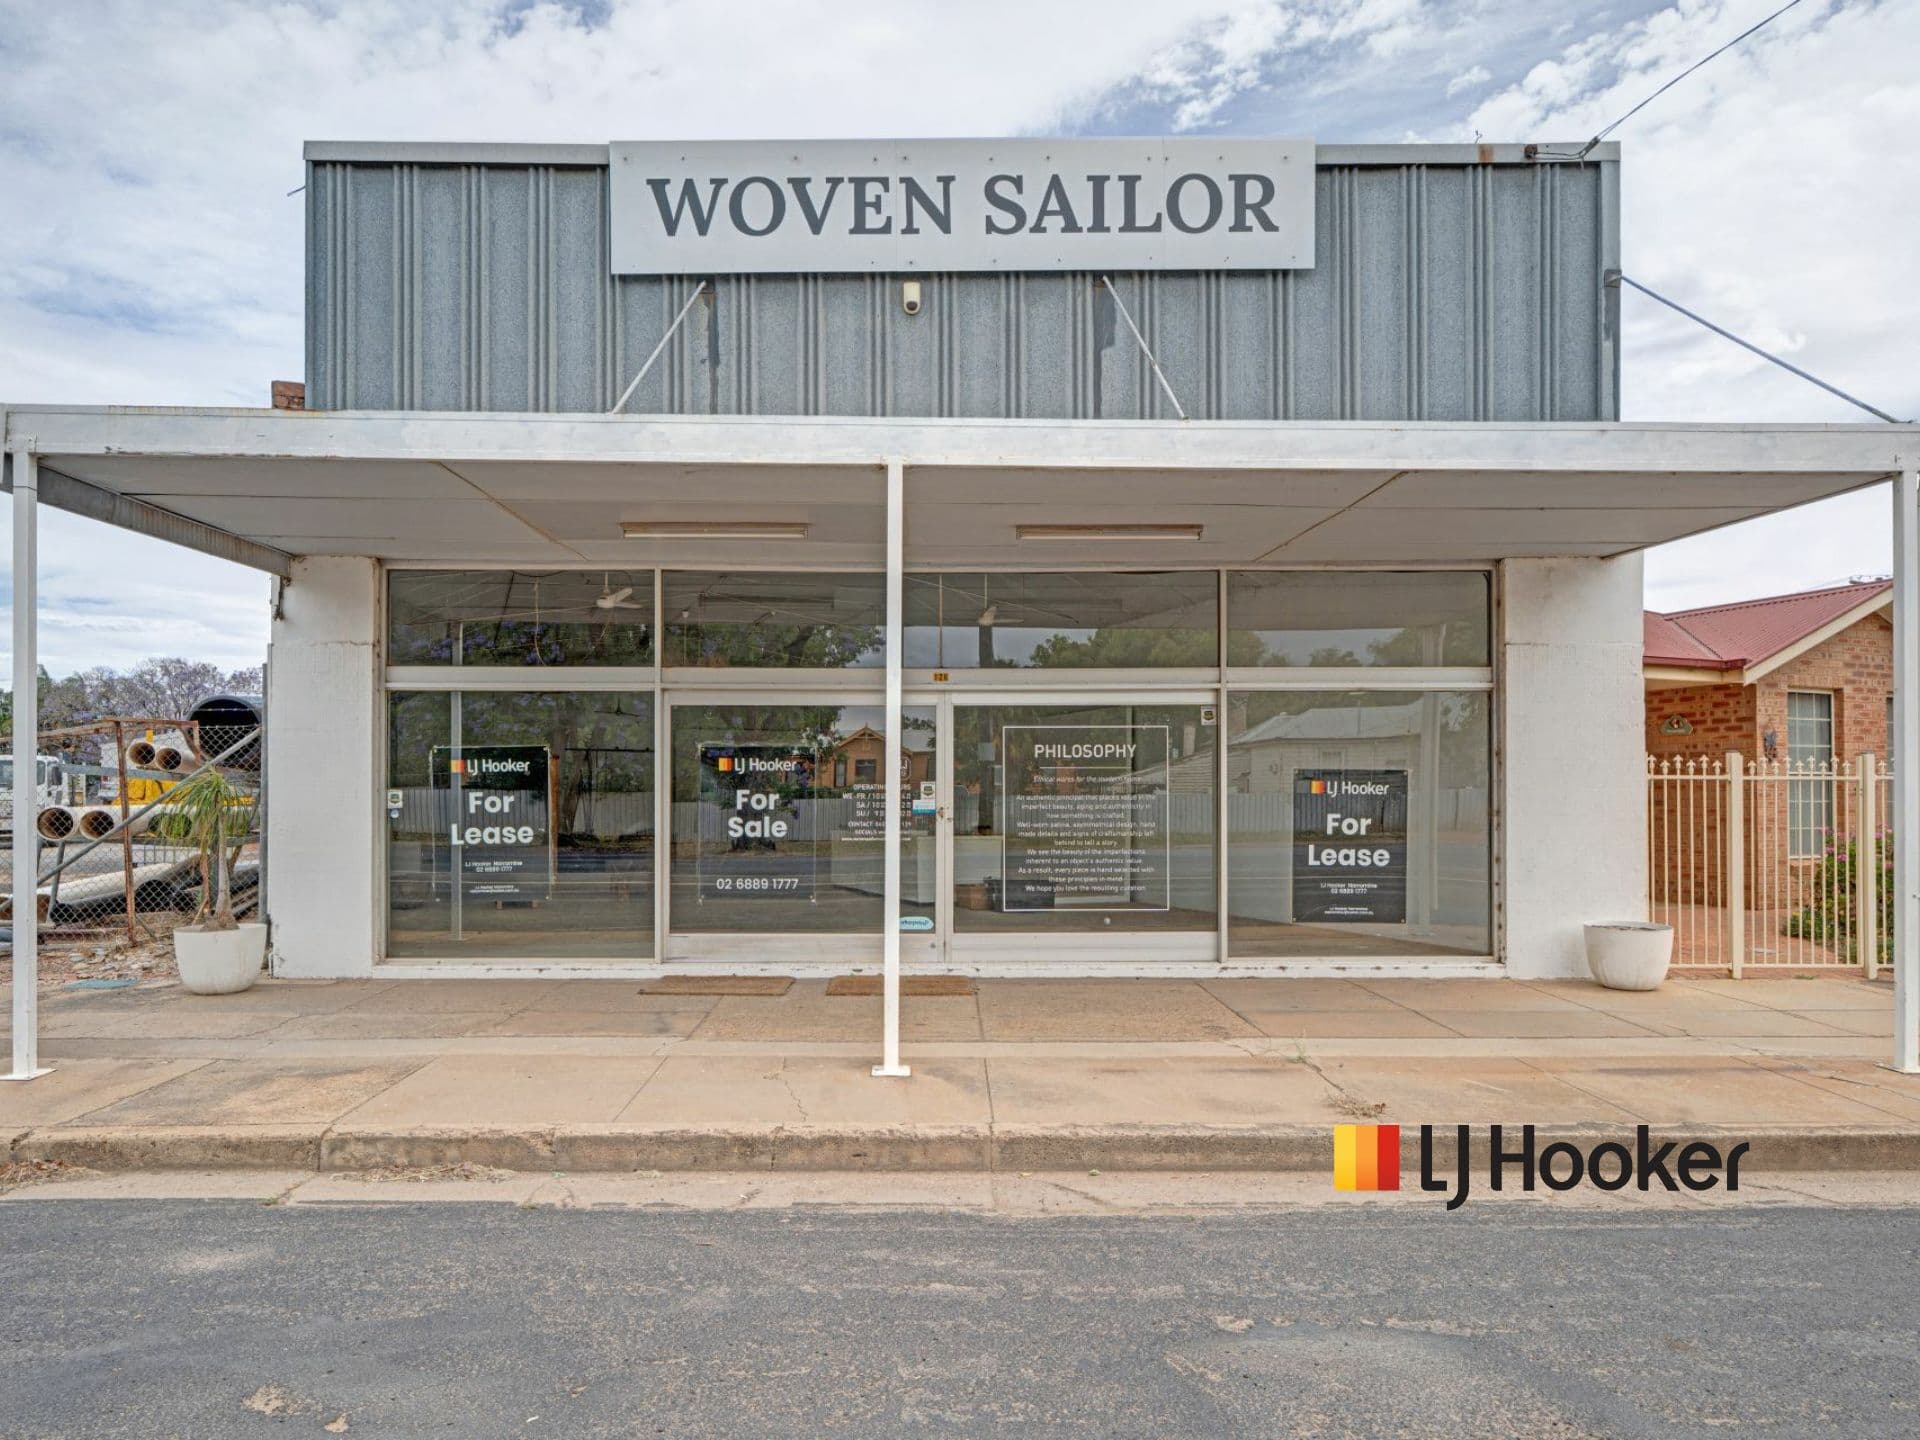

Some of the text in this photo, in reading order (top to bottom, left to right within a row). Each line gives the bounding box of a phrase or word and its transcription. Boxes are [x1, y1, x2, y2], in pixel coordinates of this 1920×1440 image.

[646, 173, 1280, 236] WOVEN SAILOR
[1034, 744, 1136, 758] PHILOSOPHY
[467, 758, 531, 776] LJ Hooker
[734, 757, 797, 774] LJ Hooker
[736, 789, 780, 810] For
[1327, 781, 1389, 798] LJ Hooker
[469, 791, 514, 813] For
[451, 823, 534, 845] Lease
[728, 816, 788, 838] Sale
[1327, 813, 1372, 835] For
[1308, 844, 1390, 867] Lease
[716, 878, 799, 890] 02 6889 1777
